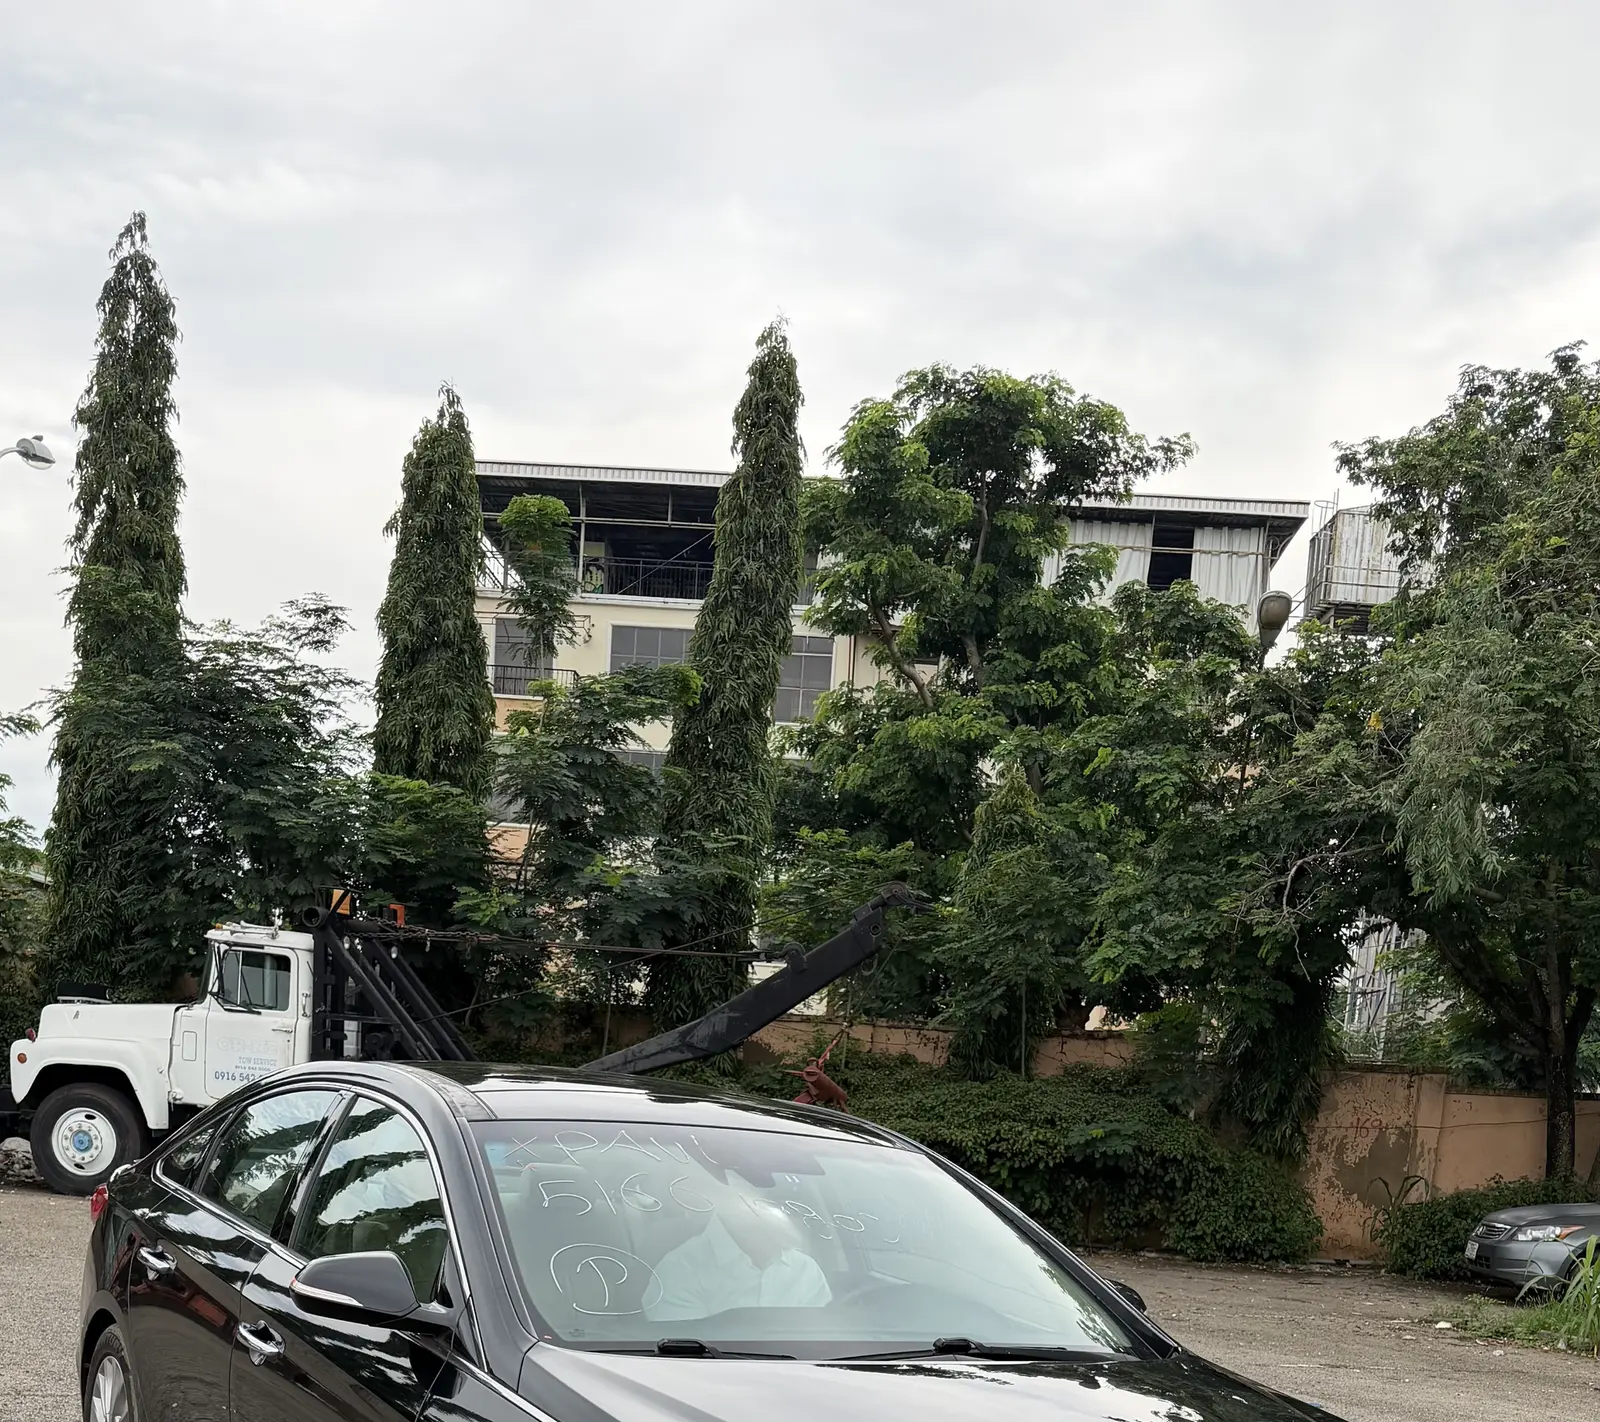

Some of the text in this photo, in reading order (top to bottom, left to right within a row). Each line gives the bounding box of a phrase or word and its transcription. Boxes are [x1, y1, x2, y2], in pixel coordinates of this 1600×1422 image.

[238, 1056, 277, 1067] TOW SERVICE
[214, 1070, 237, 1081] 0916
[239, 1072, 256, 1082] 542
[538, 1172, 715, 1216] 5166
